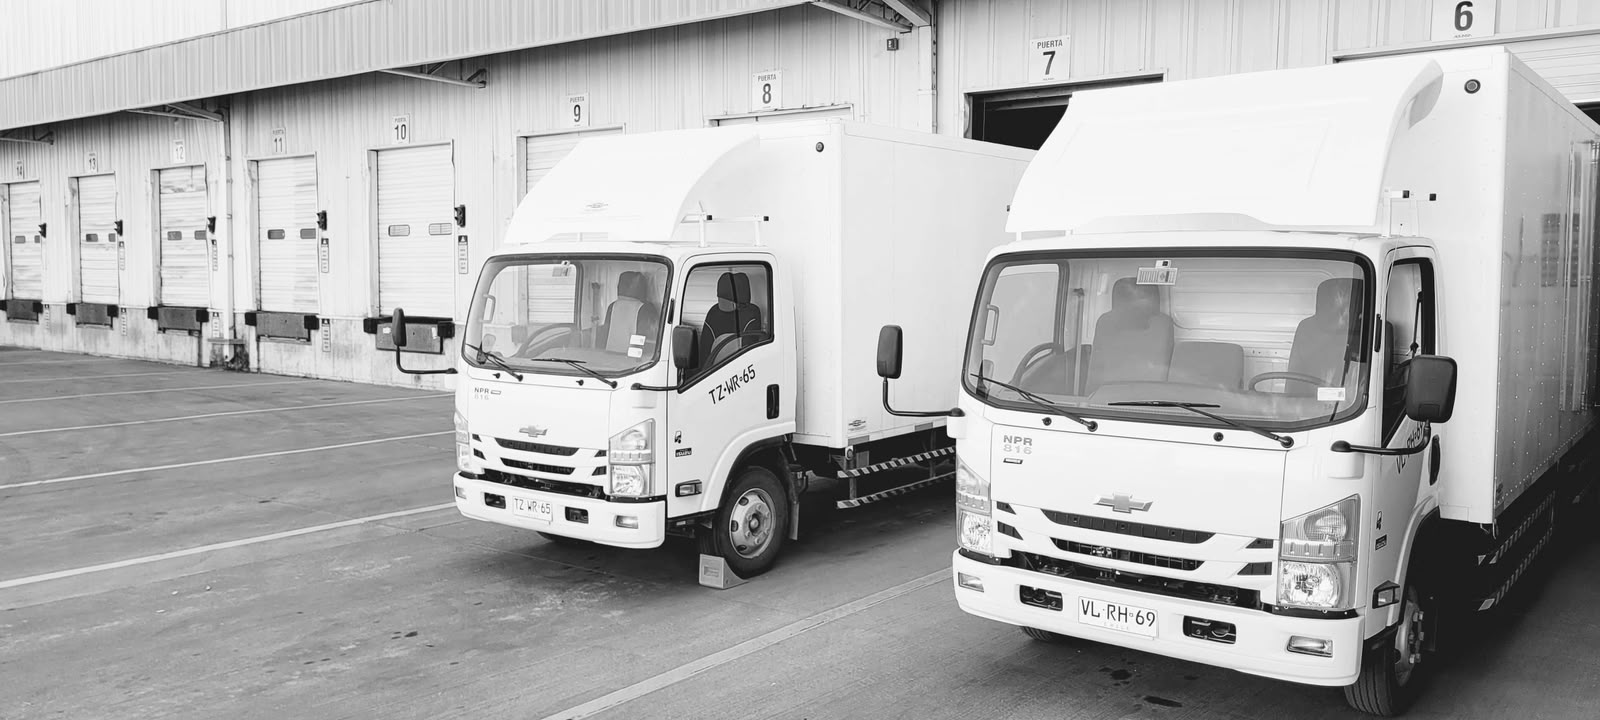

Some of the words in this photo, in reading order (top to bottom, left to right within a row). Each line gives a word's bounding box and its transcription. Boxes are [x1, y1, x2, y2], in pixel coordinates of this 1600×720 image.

[1454, 0, 1473, 31] 6
[1036, 39, 1063, 49] PUERTA
[1042, 50, 1056, 75] 7
[757, 74, 777, 82] PUERTA
[762, 83, 771, 104] 8
[573, 104, 581, 122] 9
[394, 123, 406, 141] 10
[273, 137, 283, 153] 11
[175, 146, 184, 160] 12
[88, 157, 96, 170] 13
[1003, 434, 1033, 446] NPR
[1003, 444, 1033, 455] 816
